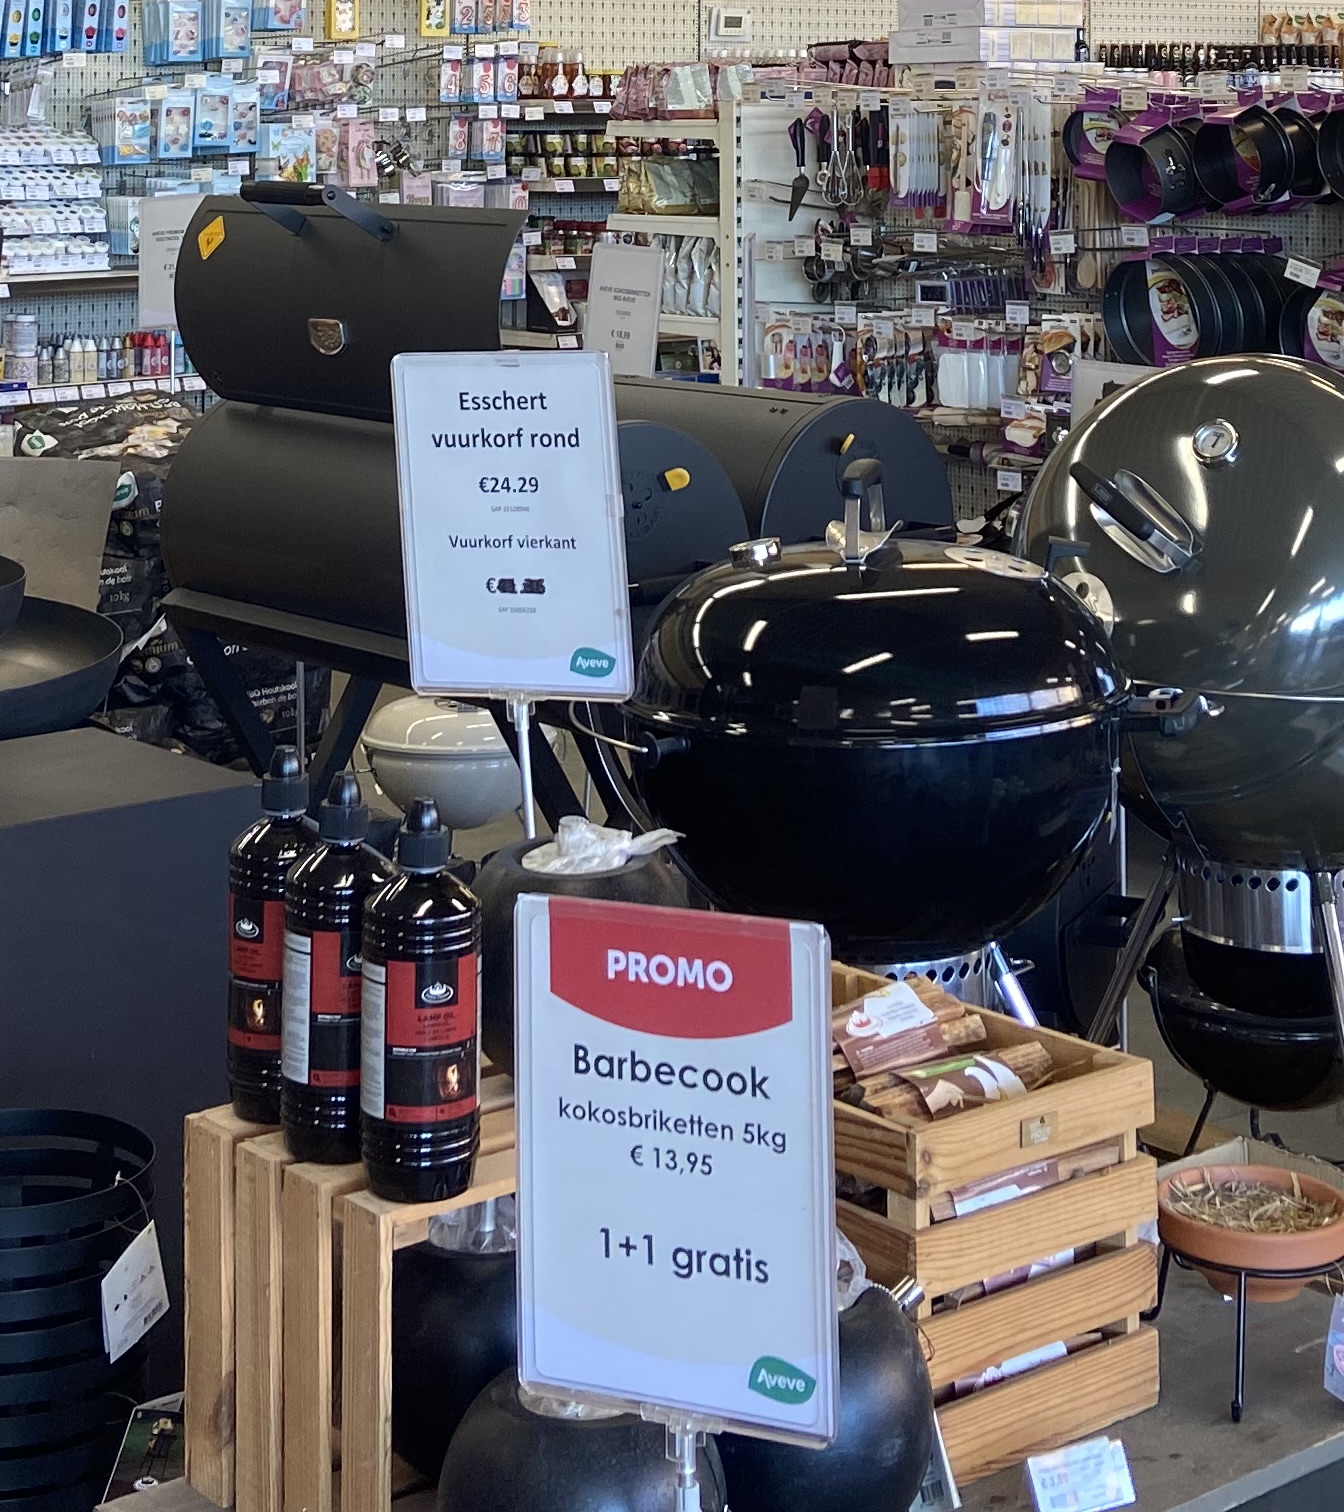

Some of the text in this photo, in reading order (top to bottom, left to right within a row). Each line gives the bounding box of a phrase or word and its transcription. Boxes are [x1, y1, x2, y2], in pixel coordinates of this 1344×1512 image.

[459, 390, 548, 411] Esschert
[431, 427, 580, 448] vuurkorf rond
[478, 476, 539, 494] €24.29
[448, 534, 577, 550] Vuurkorf vierkant
[575, 656, 610, 670] Aveve
[607, 948, 734, 993] PROMO
[573, 1043, 771, 1100] Barbecook
[558, 1096, 787, 1154] kokosbriketten 5kg
[629, 1143, 714, 1176] € 13,95
[599, 1227, 770, 1284] 1+1 gratis
[757, 1367, 806, 1393] Aveve
